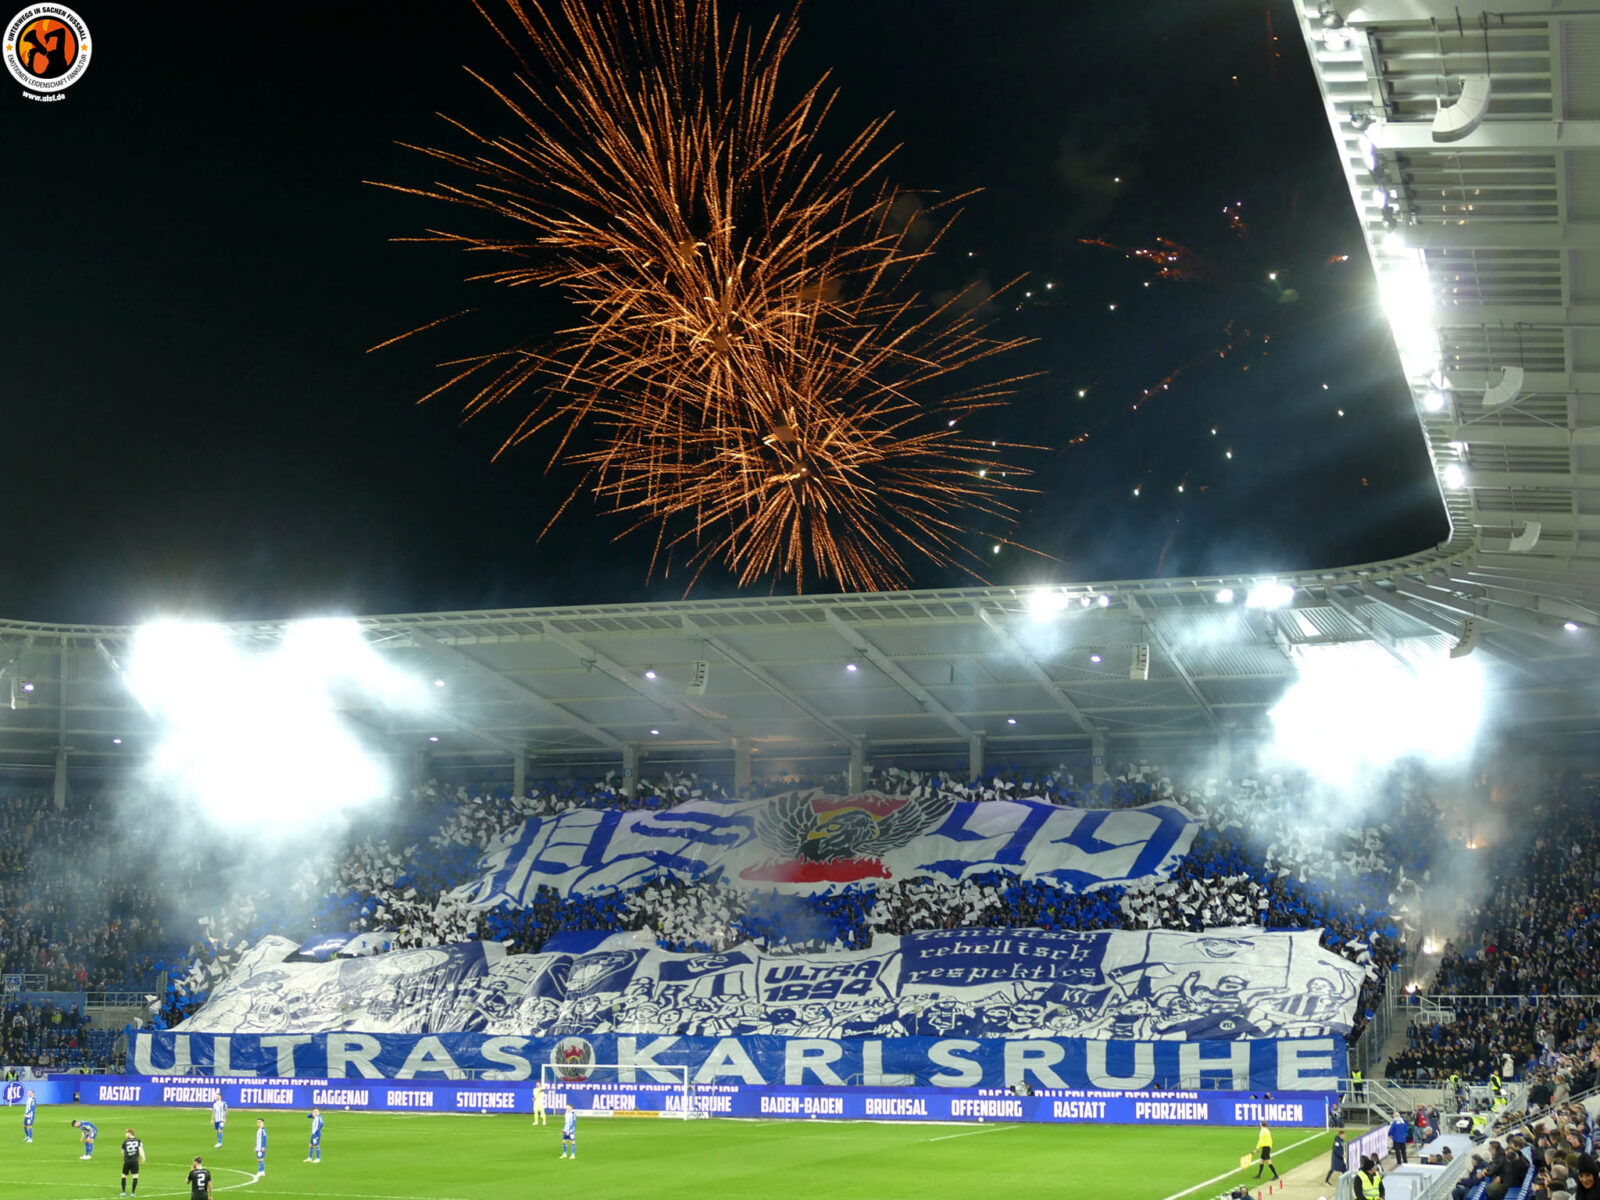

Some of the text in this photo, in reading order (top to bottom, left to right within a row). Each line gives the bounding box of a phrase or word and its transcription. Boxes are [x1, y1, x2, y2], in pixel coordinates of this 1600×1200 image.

[919, 939, 1092, 962] rebellisch
[764, 960, 882, 983] ULTRA
[908, 962, 1098, 983] respektlos
[764, 979, 873, 1002] 1894
[1061, 989, 1096, 1005] KSC
[133, 1033, 1338, 1091] ULTRAS KARLSRUHE
[99, 1086, 141, 1101] RASTATT
[163, 1087, 220, 1103] PFORZHEIM
[240, 1088, 293, 1104] ETTLINGEN
[313, 1089, 368, 1106] GAGGENAU
[387, 1091, 433, 1107] BRETTEN
[456, 1092, 514, 1109] STUTENSEE
[592, 1094, 636, 1110] ACHERN
[761, 1096, 843, 1115] BADEN-BADEN
[865, 1098, 928, 1116] BRUCHSAL
[951, 1100, 1022, 1117] OFFENBURG
[1053, 1101, 1106, 1118] RASTATT
[1135, 1102, 1208, 1120] PFORZHEIM
[1235, 1103, 1303, 1121] ETTLINGEN
[126, 1140, 139, 1152] 22
[197, 1173, 205, 1187] 2
